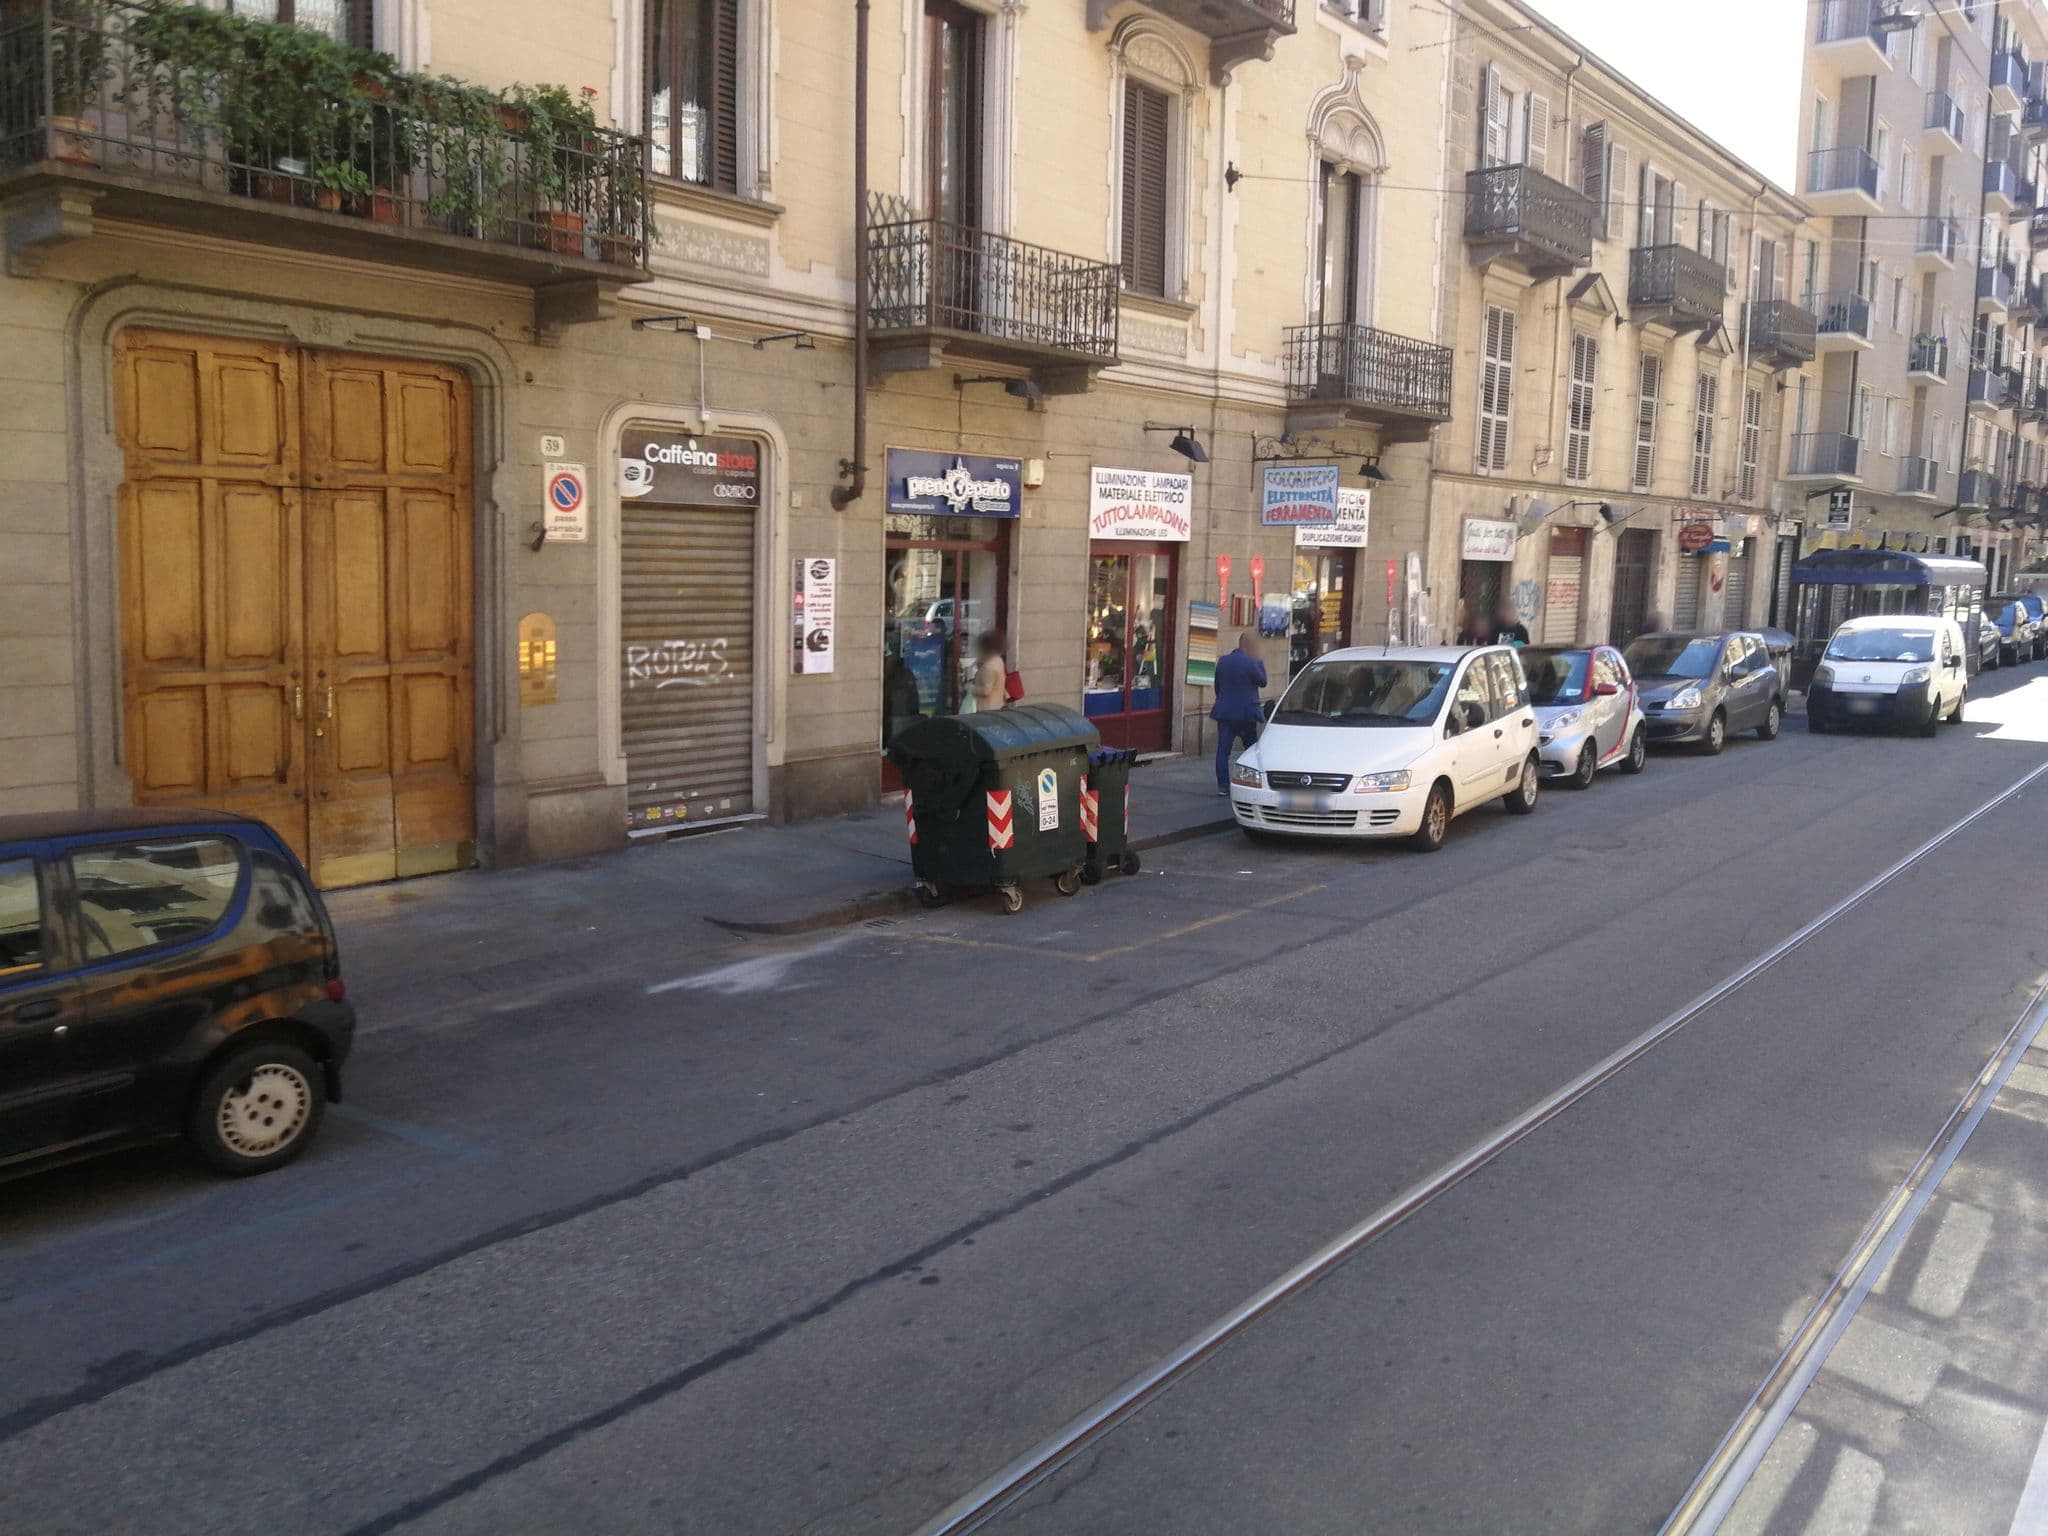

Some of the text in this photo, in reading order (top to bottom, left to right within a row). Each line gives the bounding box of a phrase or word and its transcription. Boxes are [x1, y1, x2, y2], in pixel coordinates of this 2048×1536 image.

[545, 440, 560, 452] 39
[1096, 472, 1189, 491] ILLUMINAZIONE LAMPADARI
[1267, 470, 1337, 489] COLORIFICIO
[1099, 487, 1185, 504] MATERIALE ELETTRICO
[1092, 504, 1189, 536] TUTTOLAMPADINE
[1265, 503, 1334, 523] FERRAMENTA
[1115, 527, 1156, 537] ILLUMINAZIONE
